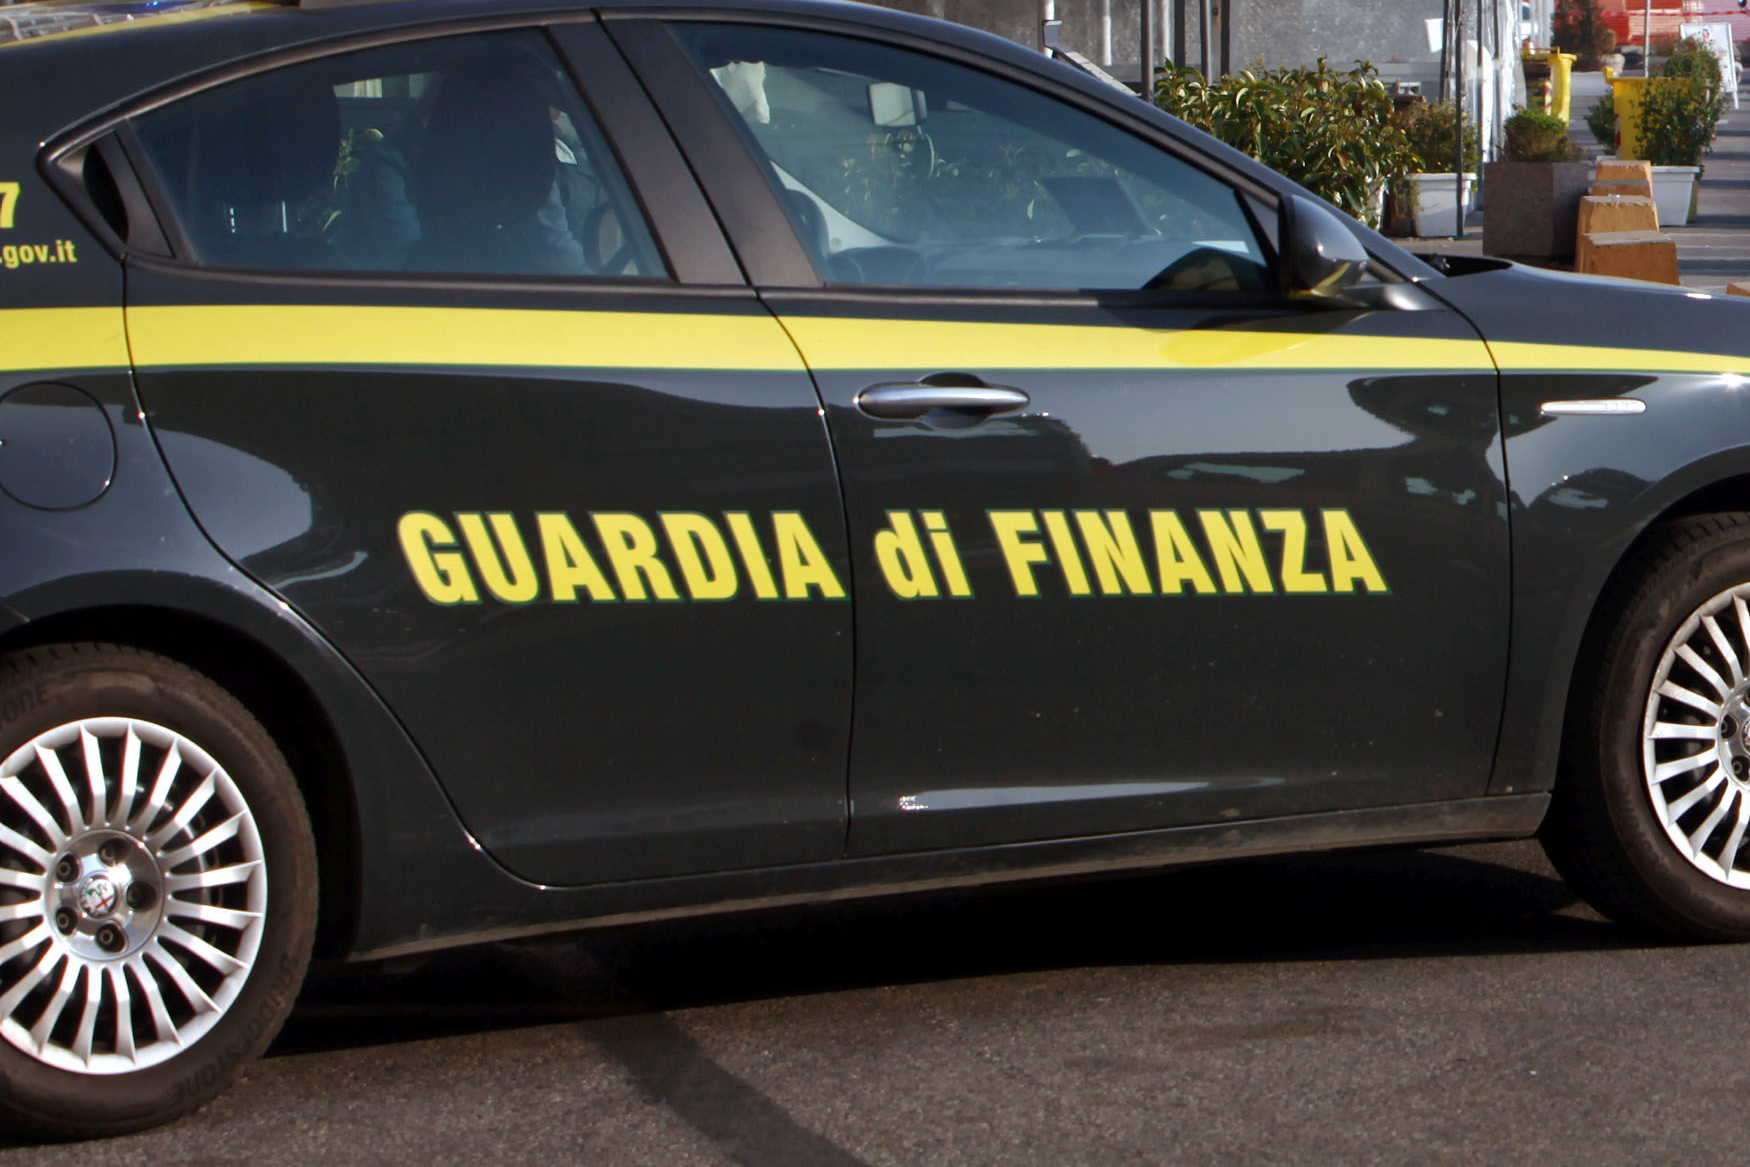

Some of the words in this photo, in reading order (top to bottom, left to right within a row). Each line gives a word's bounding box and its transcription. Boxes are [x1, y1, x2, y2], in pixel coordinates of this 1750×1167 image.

[397, 510, 851, 606] GUARDIA
[874, 508, 974, 600] di
[985, 507, 1392, 598] FINANZA
